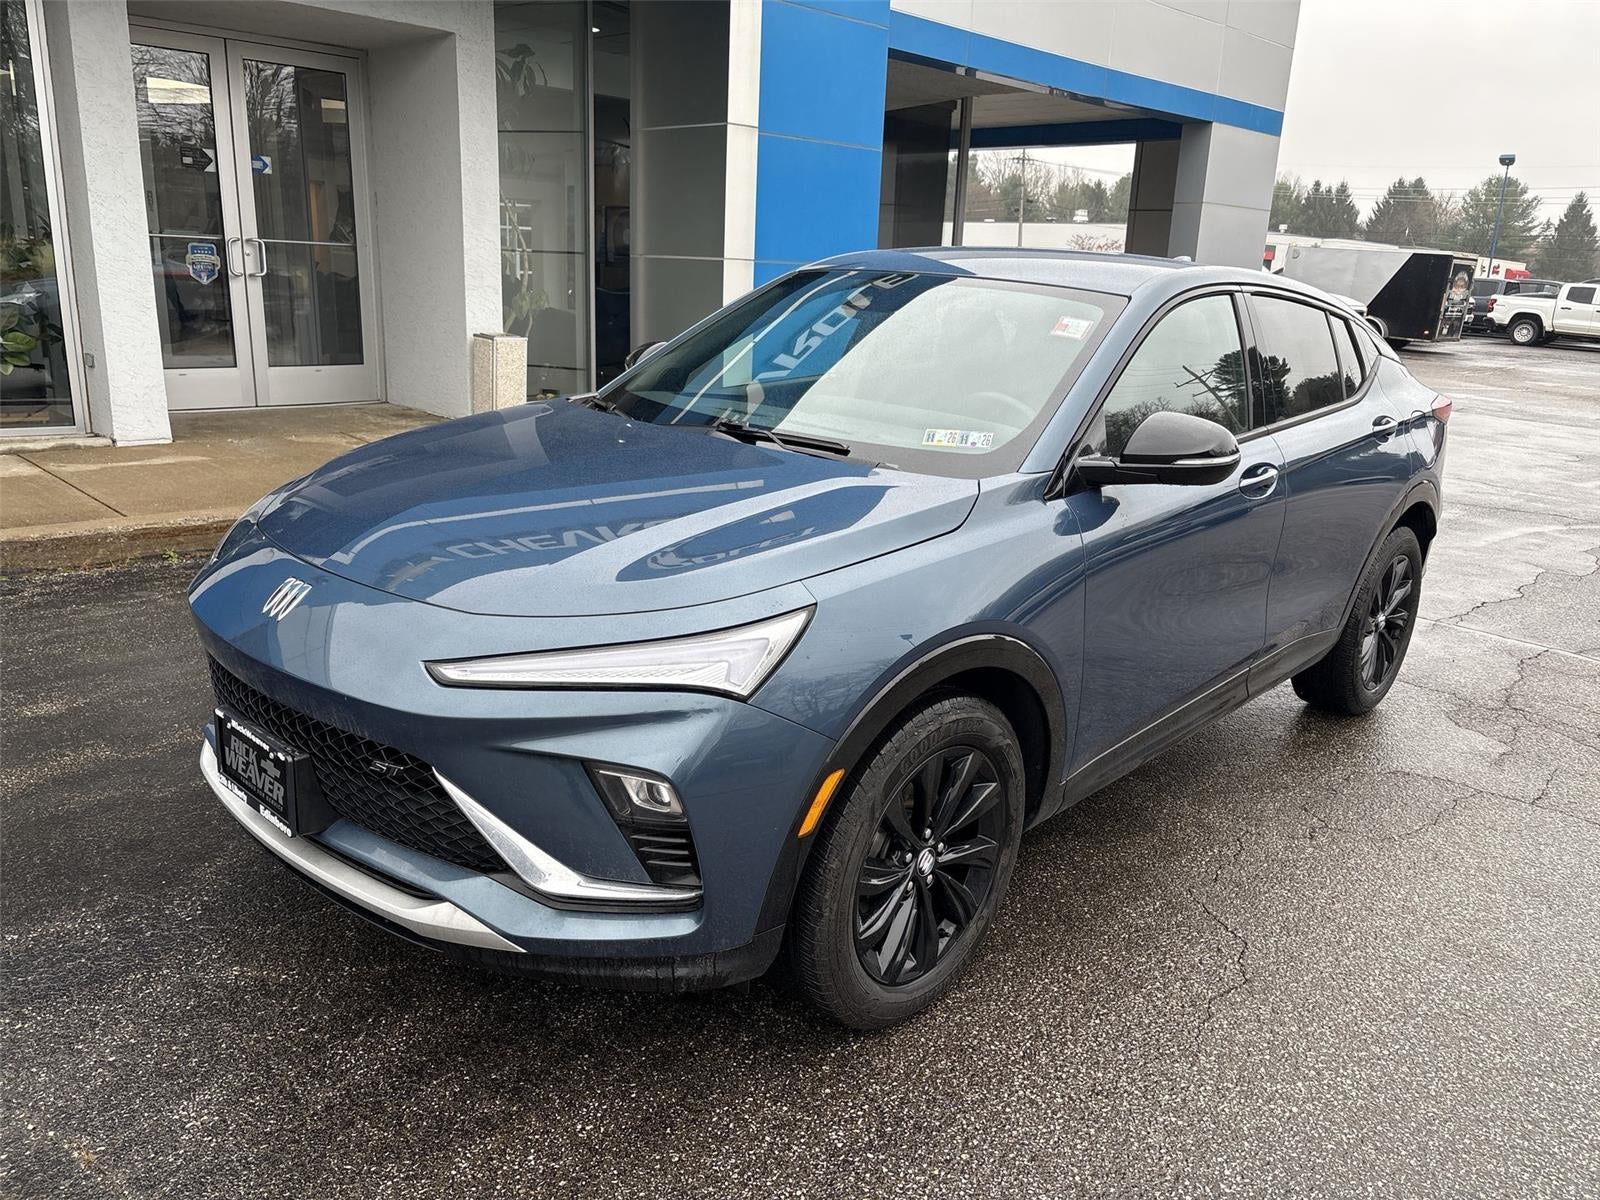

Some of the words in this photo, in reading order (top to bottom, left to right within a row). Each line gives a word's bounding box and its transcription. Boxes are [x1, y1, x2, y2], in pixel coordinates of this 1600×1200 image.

[230, 735, 257, 764] RICK
[225, 746, 284, 806] WEAVER
[369, 760, 404, 776] ST
